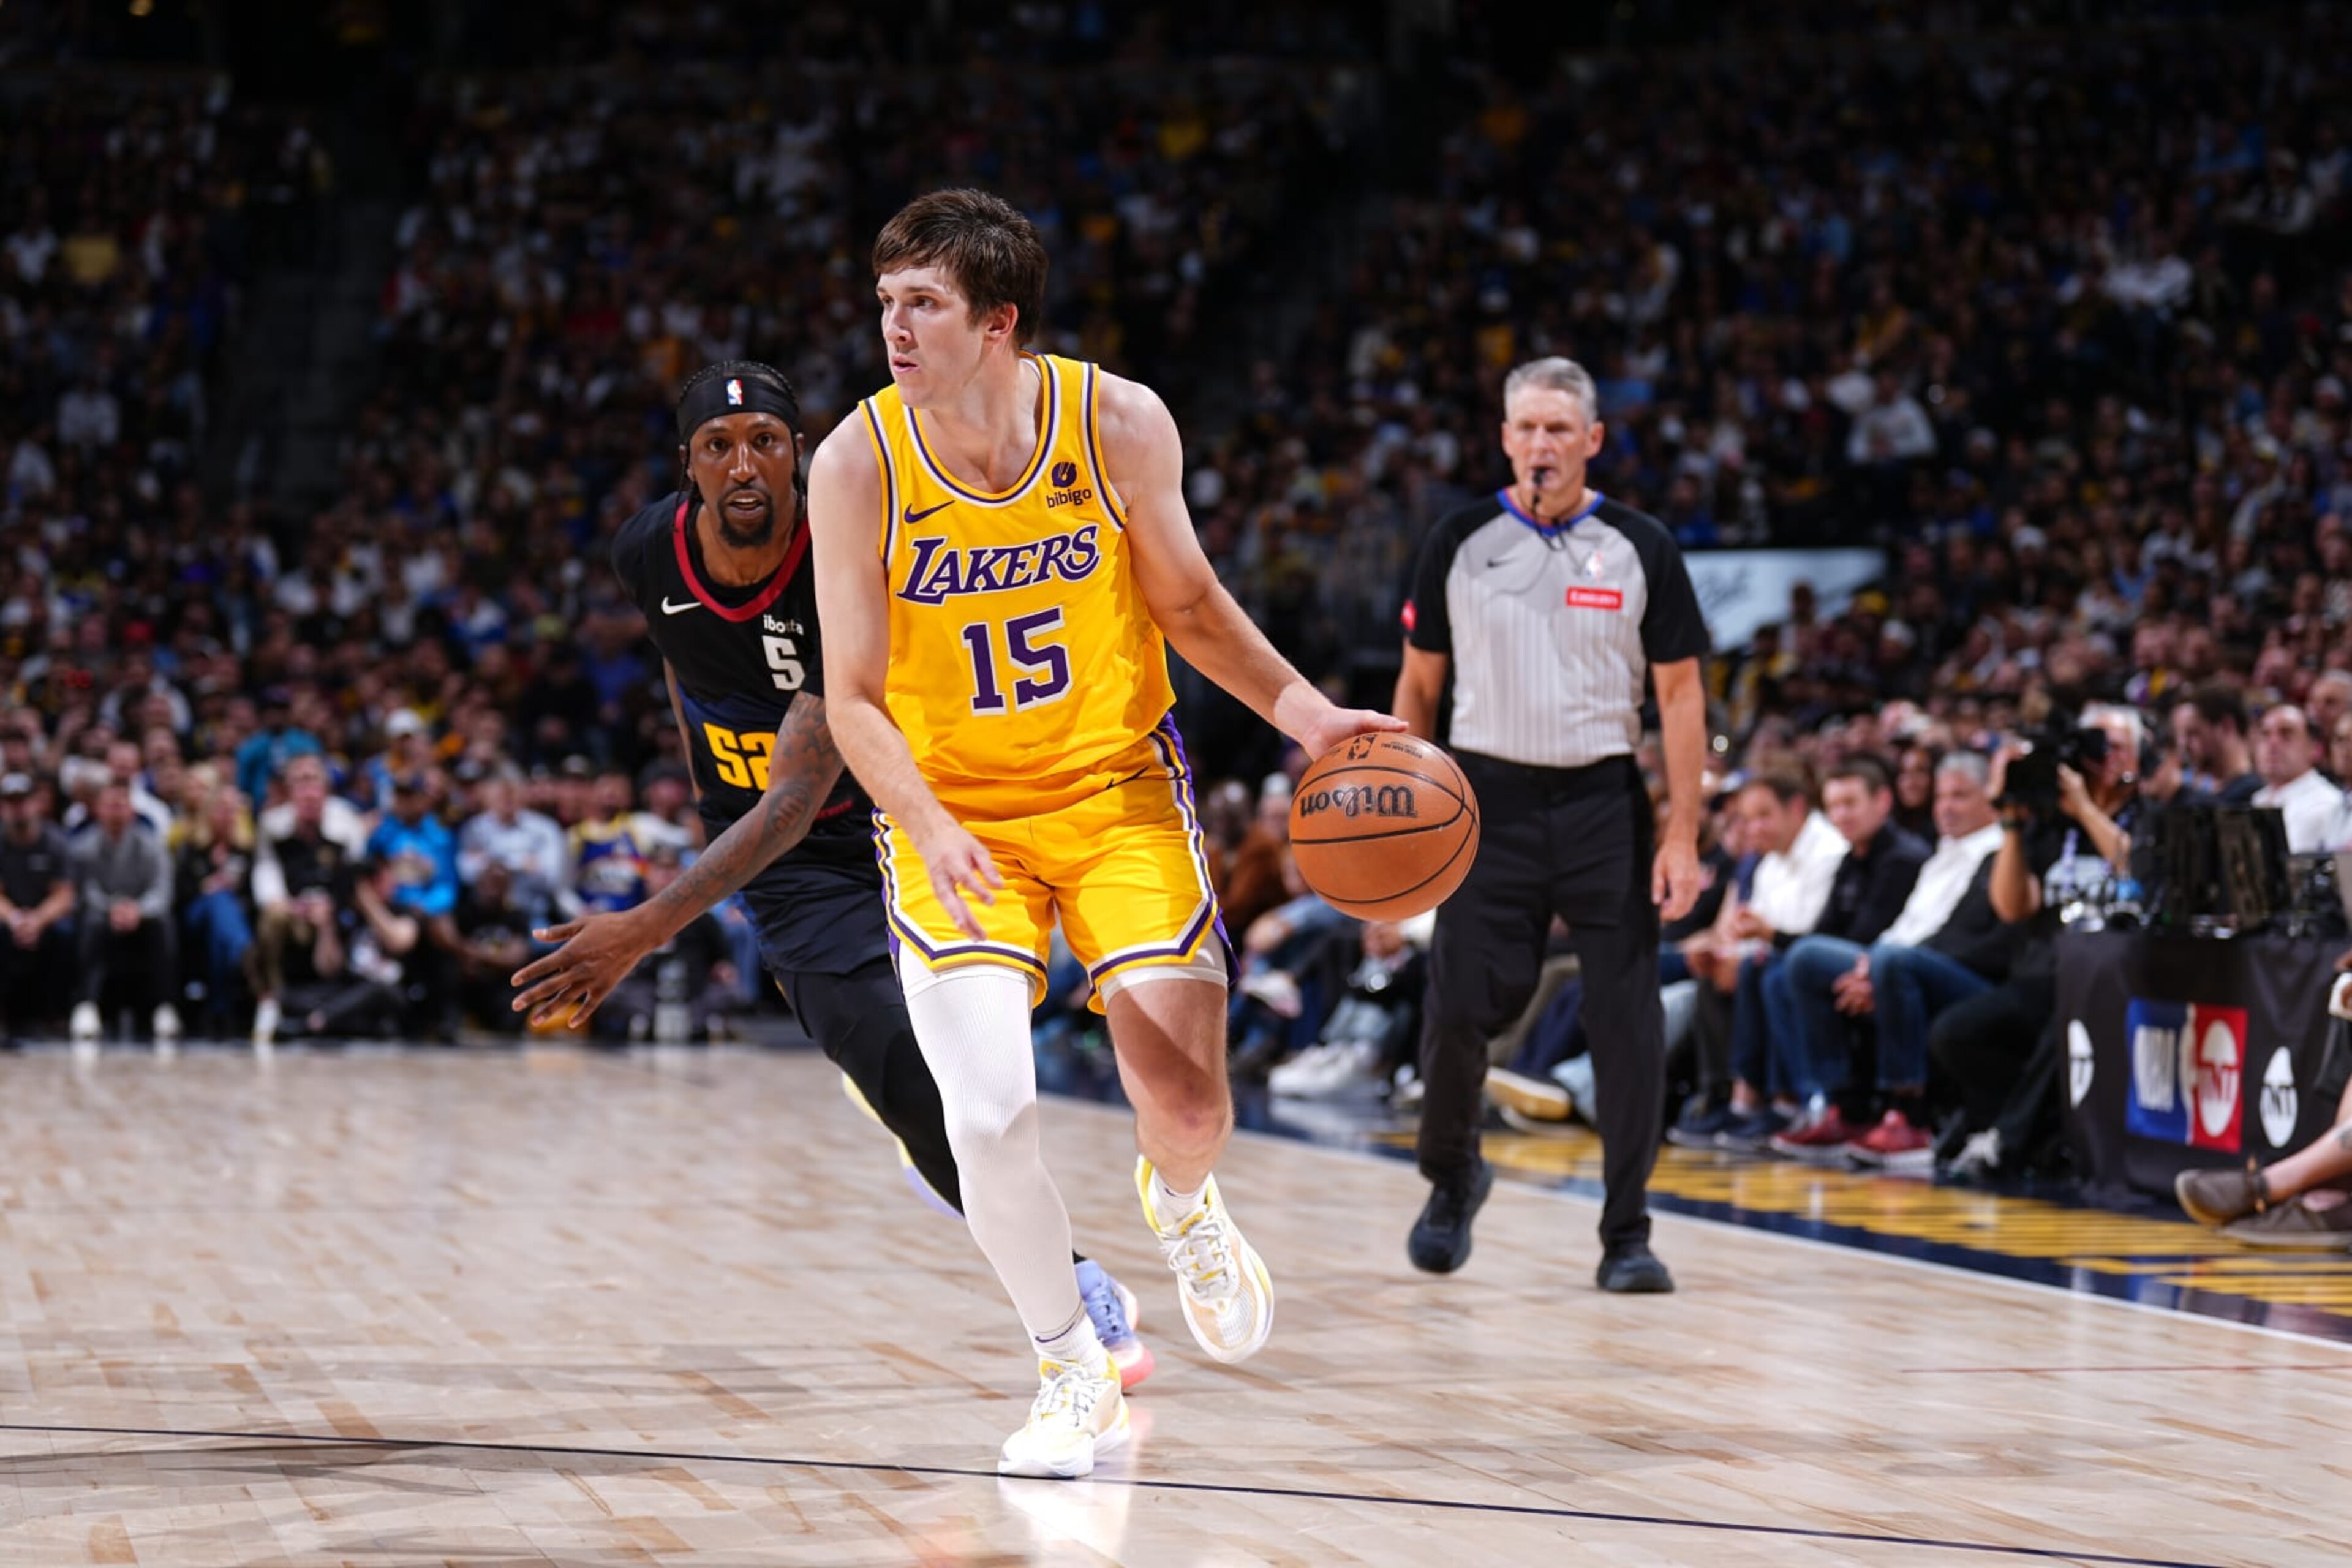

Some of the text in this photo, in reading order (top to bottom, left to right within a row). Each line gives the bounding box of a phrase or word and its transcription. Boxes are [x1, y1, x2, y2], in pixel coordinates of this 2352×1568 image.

[1046, 488, 1092, 509] bibigo
[896, 524, 1101, 607] LAKERS
[761, 635, 805, 691] 5
[962, 605, 1073, 716] 15
[1300, 784, 1417, 818] Wilson
